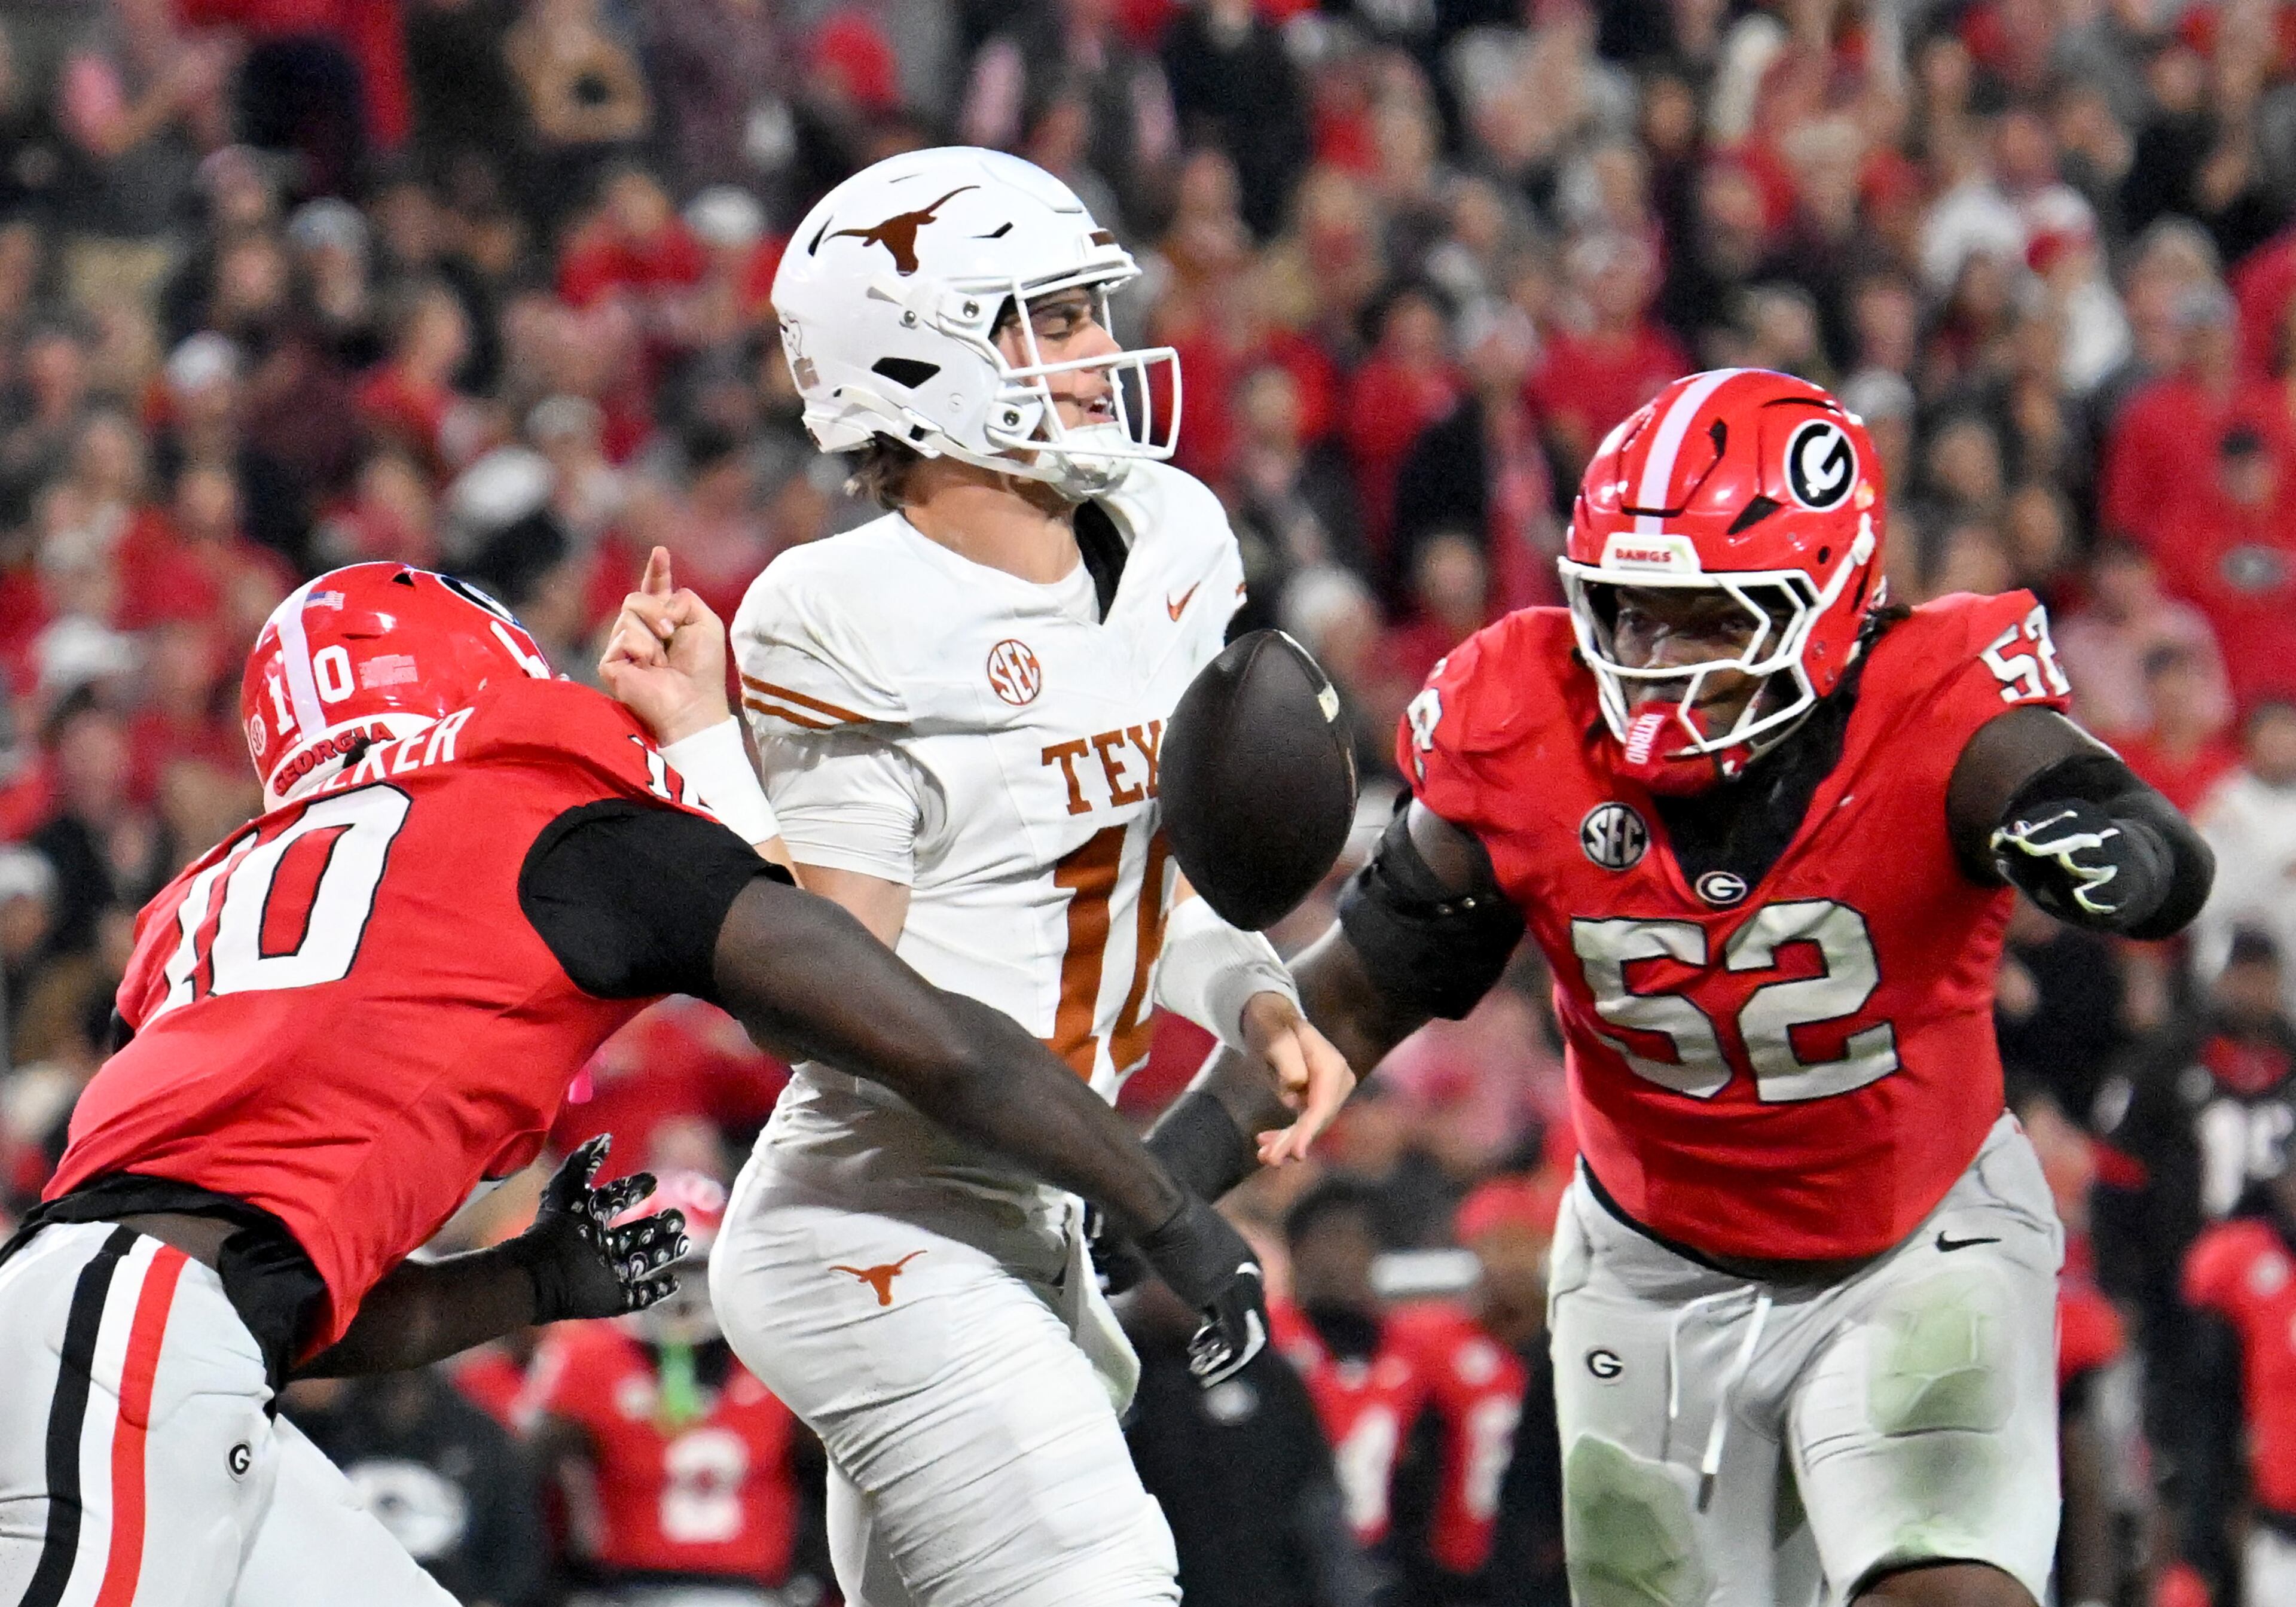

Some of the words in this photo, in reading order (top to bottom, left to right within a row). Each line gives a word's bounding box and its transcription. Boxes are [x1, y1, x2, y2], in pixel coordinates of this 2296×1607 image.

[1615, 548, 1671, 563] DAWGS
[265, 644, 355, 736] 10
[987, 638, 1041, 706] SEC
[273, 721, 396, 797] GEORGIA
[1583, 804, 1645, 868] SEC
[135, 780, 414, 1038] 10
[1570, 898, 1900, 1105] 52
